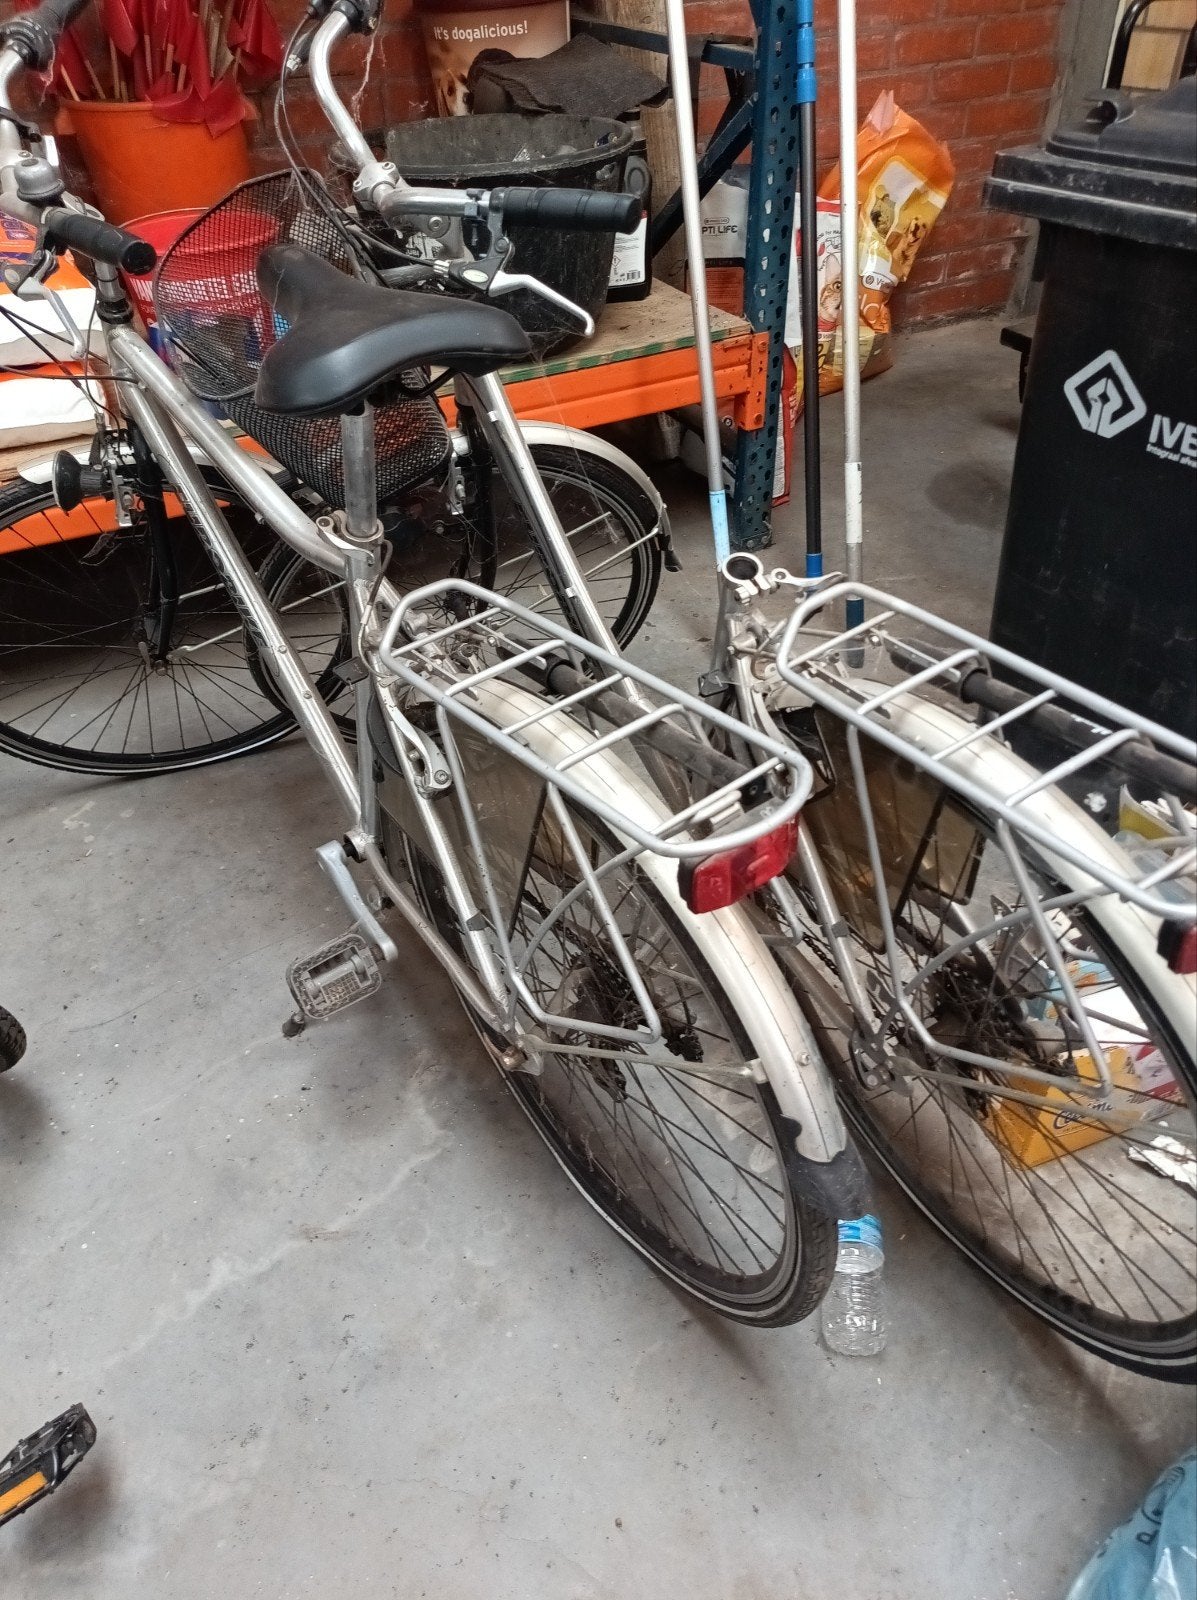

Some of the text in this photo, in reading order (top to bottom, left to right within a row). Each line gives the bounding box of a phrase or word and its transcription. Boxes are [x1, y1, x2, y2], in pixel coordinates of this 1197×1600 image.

[433, 20, 528, 42] It's dogalicious!
[701, 225, 738, 235] PTI LIFE
